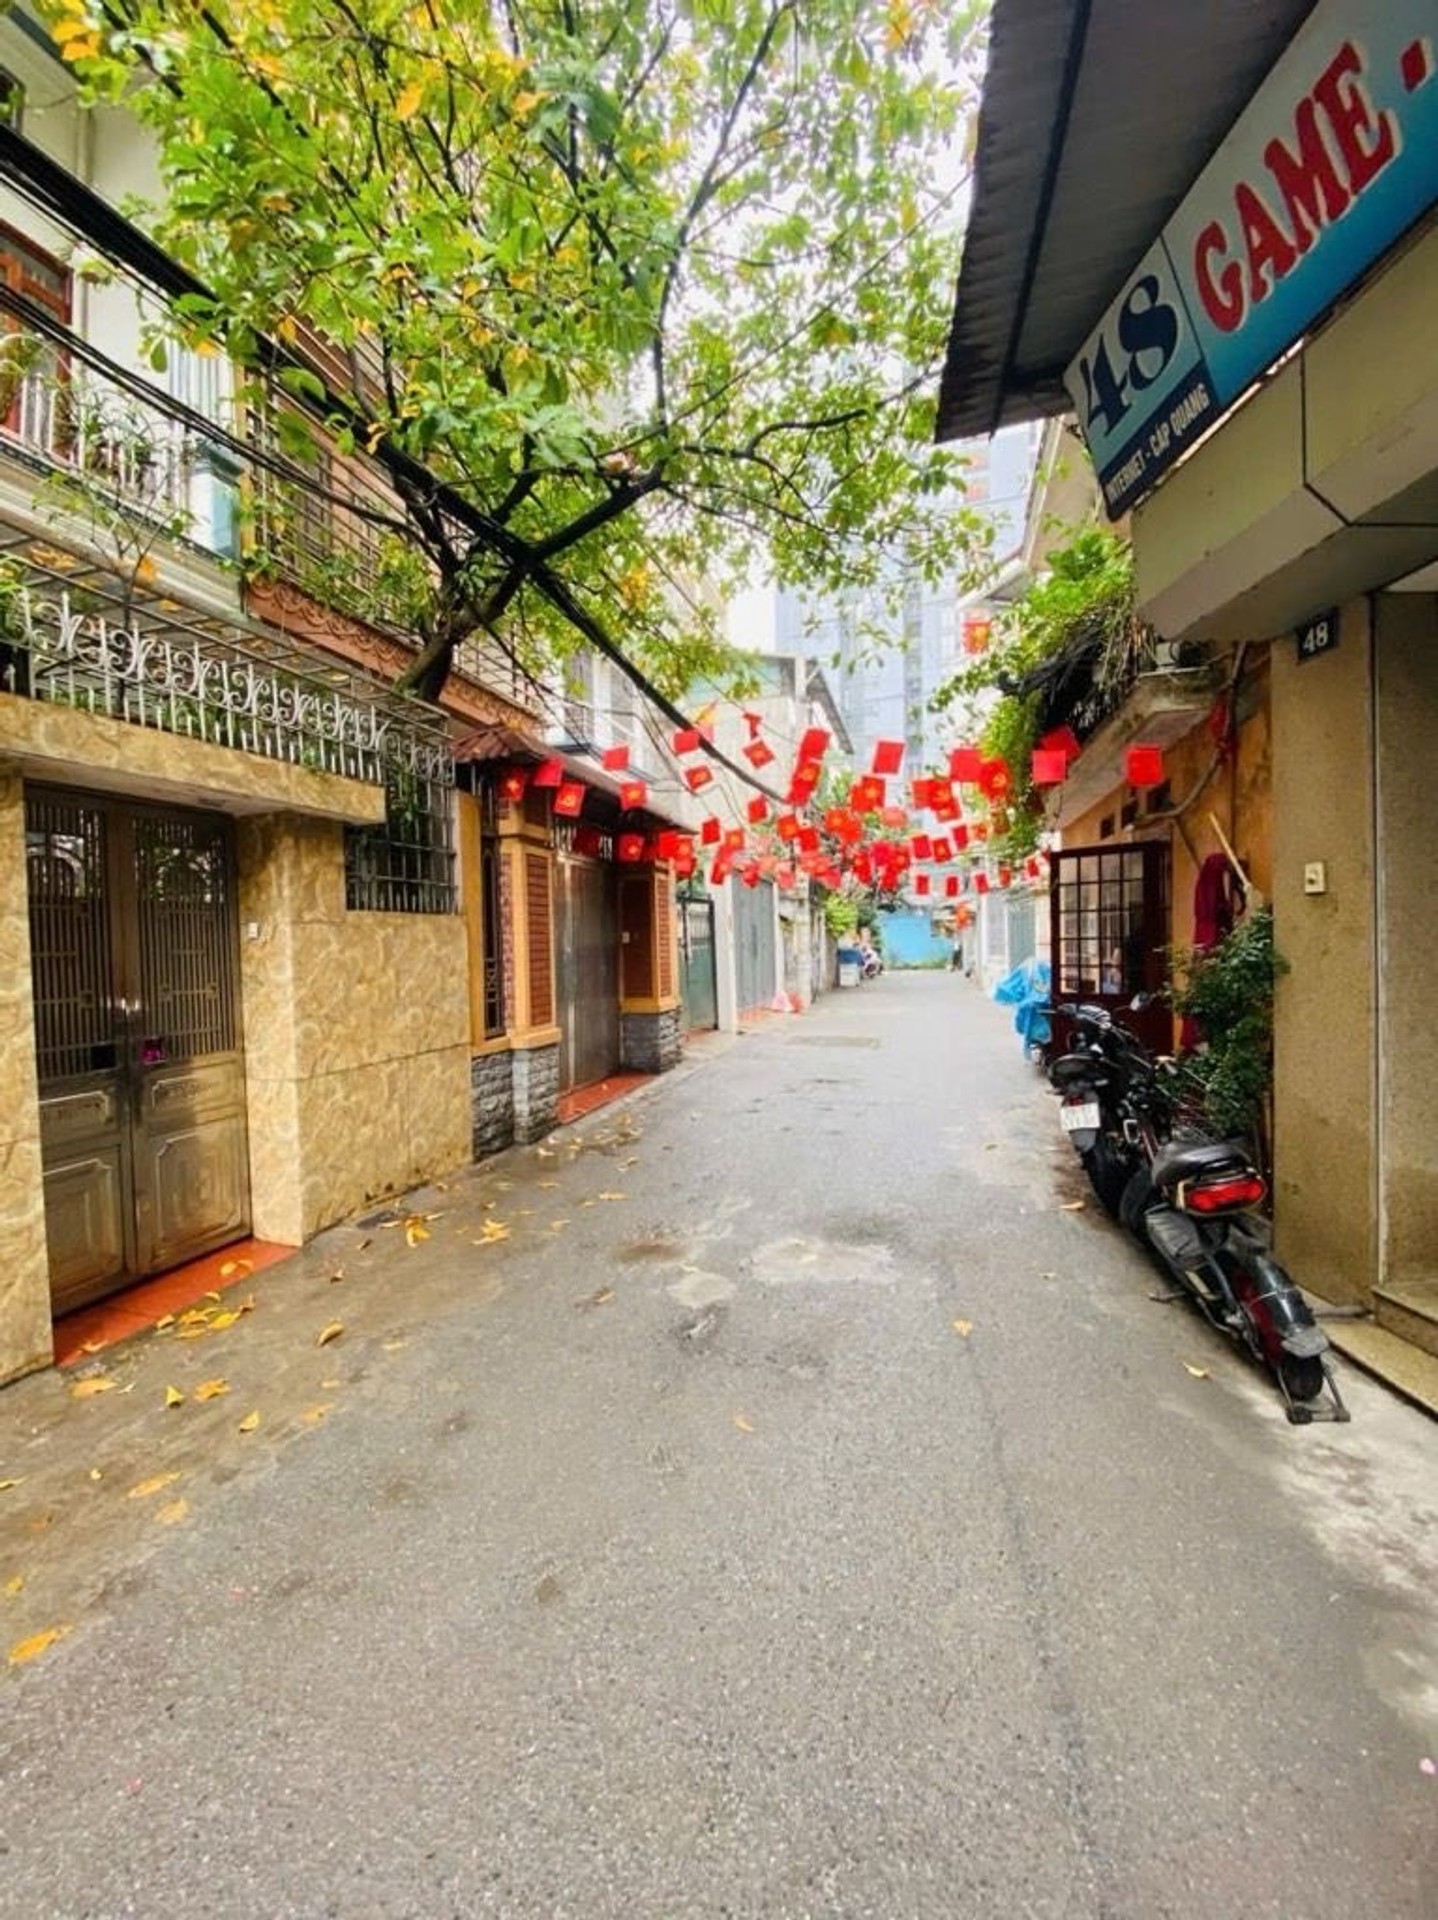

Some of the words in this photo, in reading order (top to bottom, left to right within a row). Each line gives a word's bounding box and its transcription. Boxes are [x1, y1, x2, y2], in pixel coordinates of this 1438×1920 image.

[1195, 41, 1399, 332] GAME
[1079, 275, 1178, 437] 48
[1105, 450, 1146, 503] INTERNET
[1170, 382, 1210, 436] QUANG
[1303, 621, 1329, 653] 48
